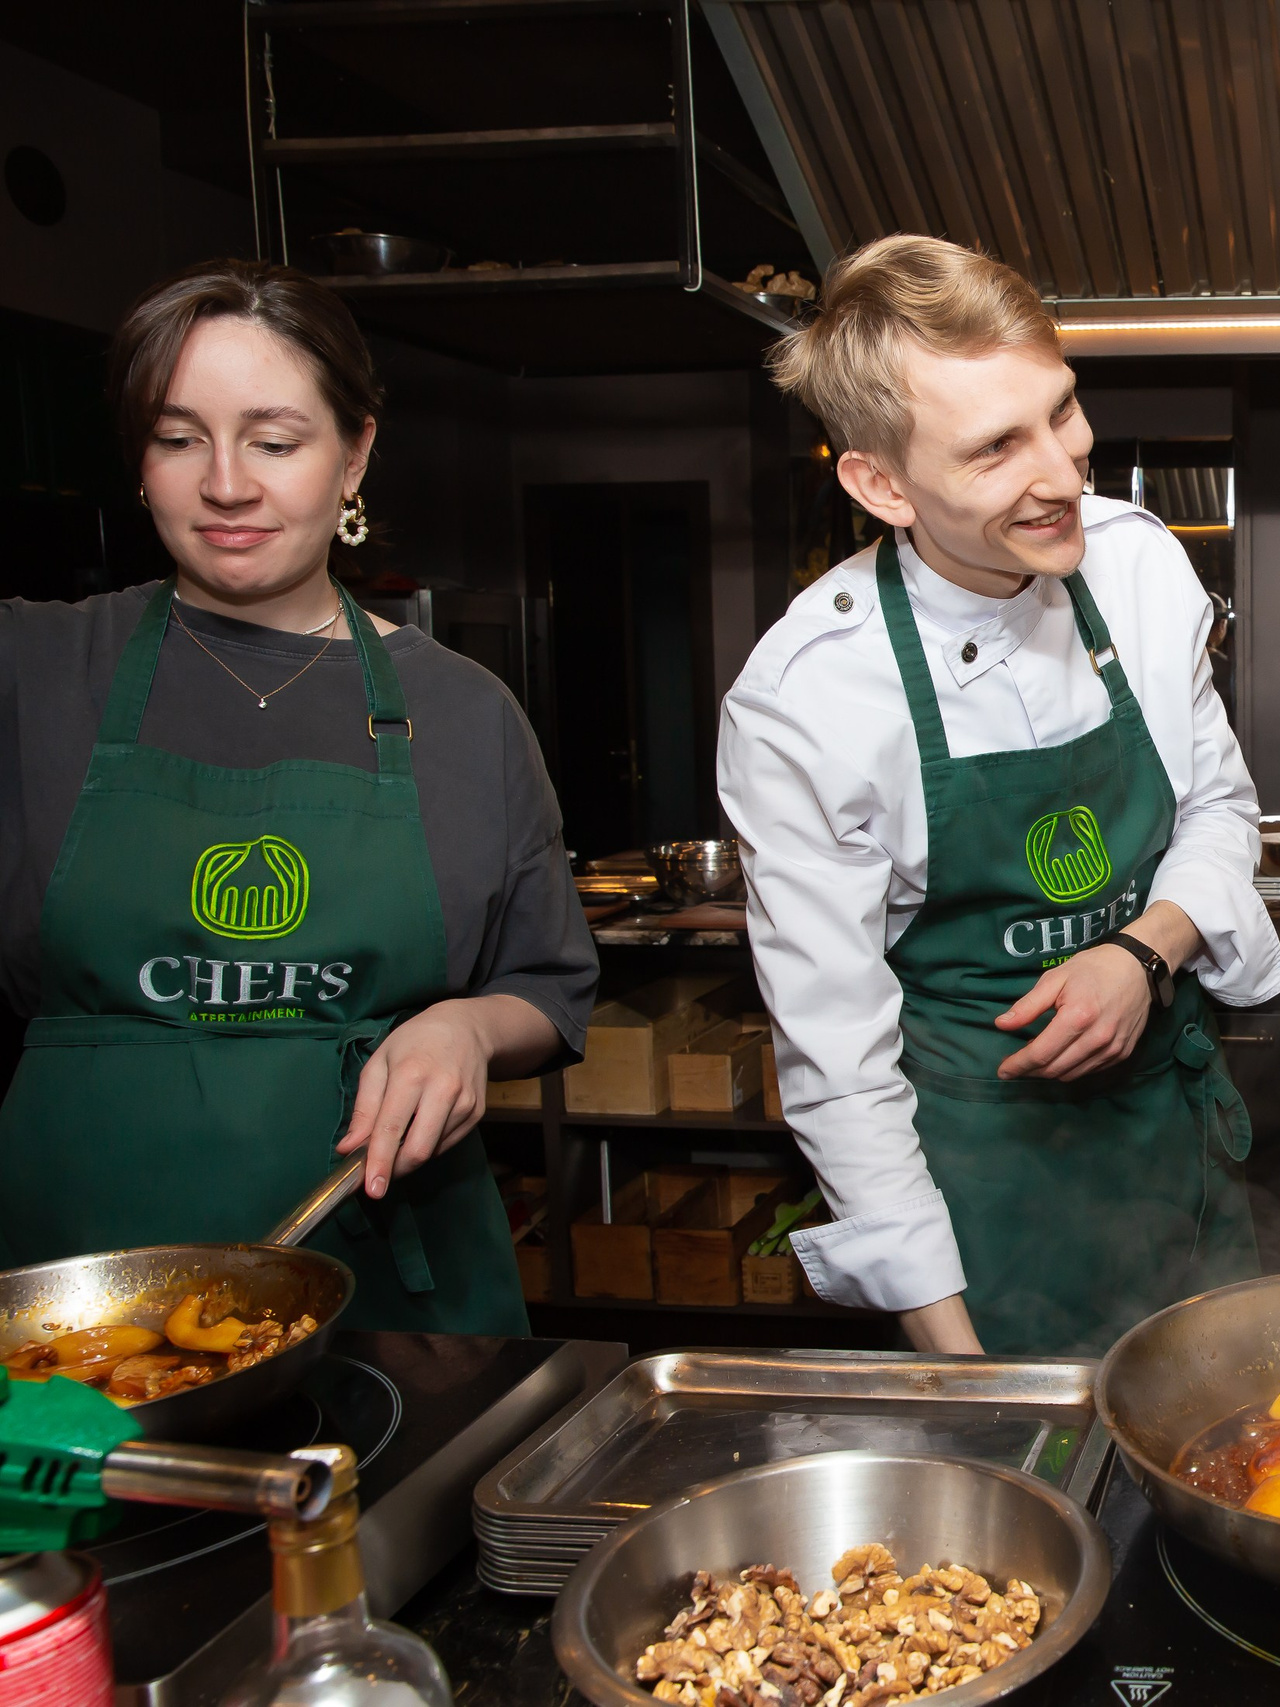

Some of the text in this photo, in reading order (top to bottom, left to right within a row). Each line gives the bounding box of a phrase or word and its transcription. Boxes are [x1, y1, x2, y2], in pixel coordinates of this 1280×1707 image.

[1003, 879, 1137, 958] CHEFS
[138, 955, 353, 1005] CHEFS
[189, 1007, 306, 1023] ATERTAINMENT
